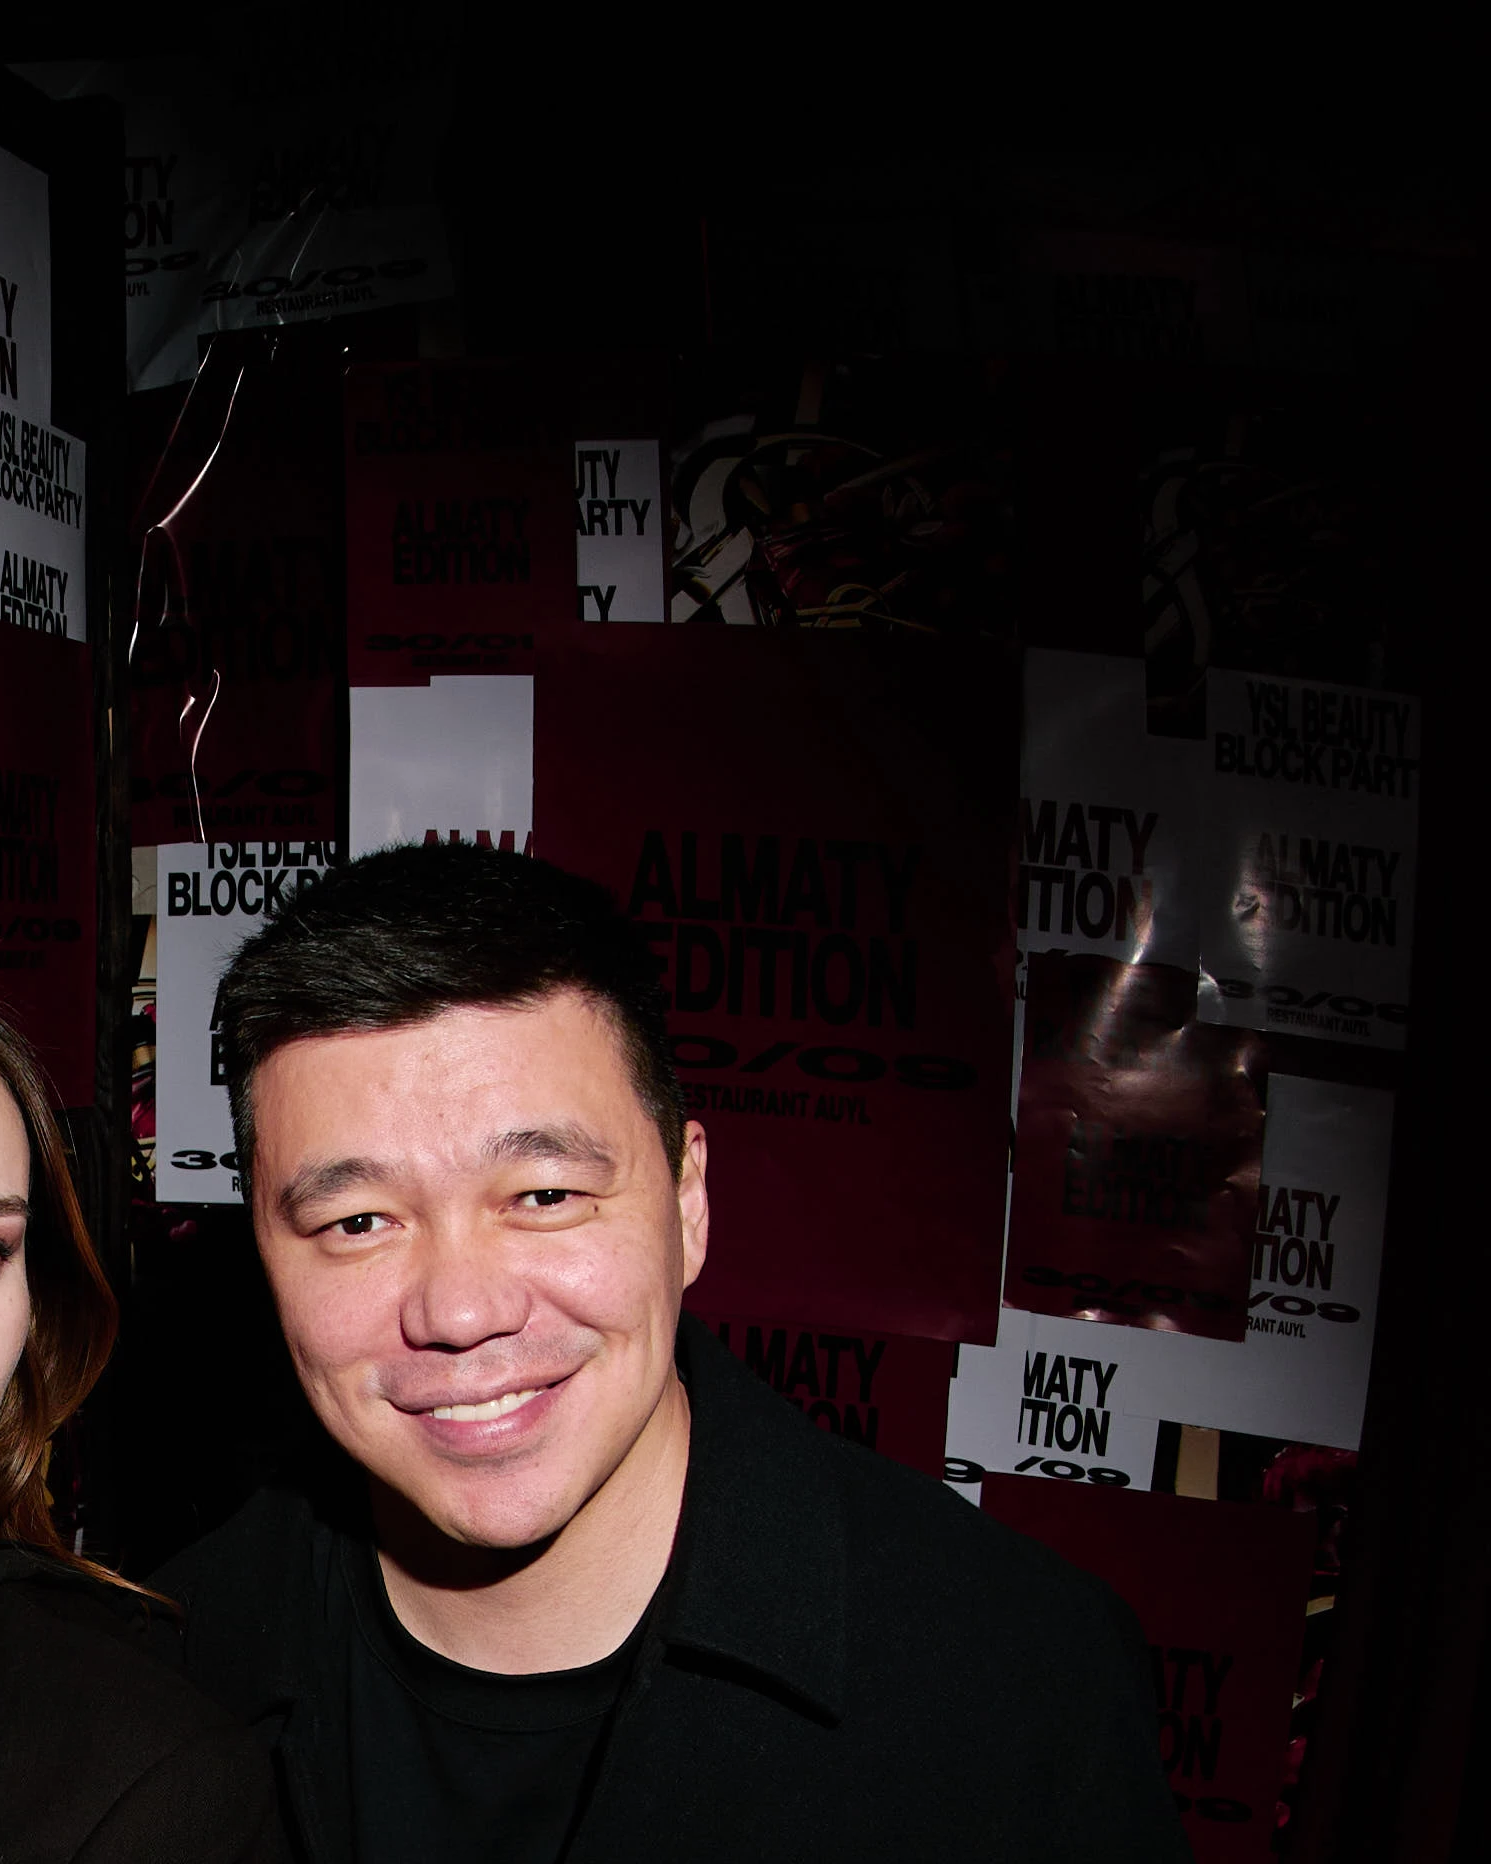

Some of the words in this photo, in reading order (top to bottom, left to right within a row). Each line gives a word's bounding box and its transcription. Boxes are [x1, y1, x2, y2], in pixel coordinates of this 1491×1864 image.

[125, 281, 150, 297] UYL
[22, 423, 70, 488] BEAUTY
[35, 482, 82, 529] PARTY
[0, 550, 68, 614] ALMATY
[1246, 680, 1296, 741] YSL
[1305, 688, 1410, 758] BEAUTY
[1215, 733, 1326, 786] BLOCK
[1331, 747, 1421, 797] PART
[1016, 798, 1158, 875] MATY
[1258, 832, 1401, 897] ALMATY
[168, 870, 288, 916] BLOCK
[630, 830, 922, 934] ALMATY
[1272, 880, 1397, 946] DITION
[668, 1034, 978, 1090] 0/09
[1254, 1234, 1334, 1291] TION
[1277, 1319, 1306, 1338] AUYL
[1023, 1350, 1118, 1408] MATY
[1014, 1456, 1131, 1488] /09
